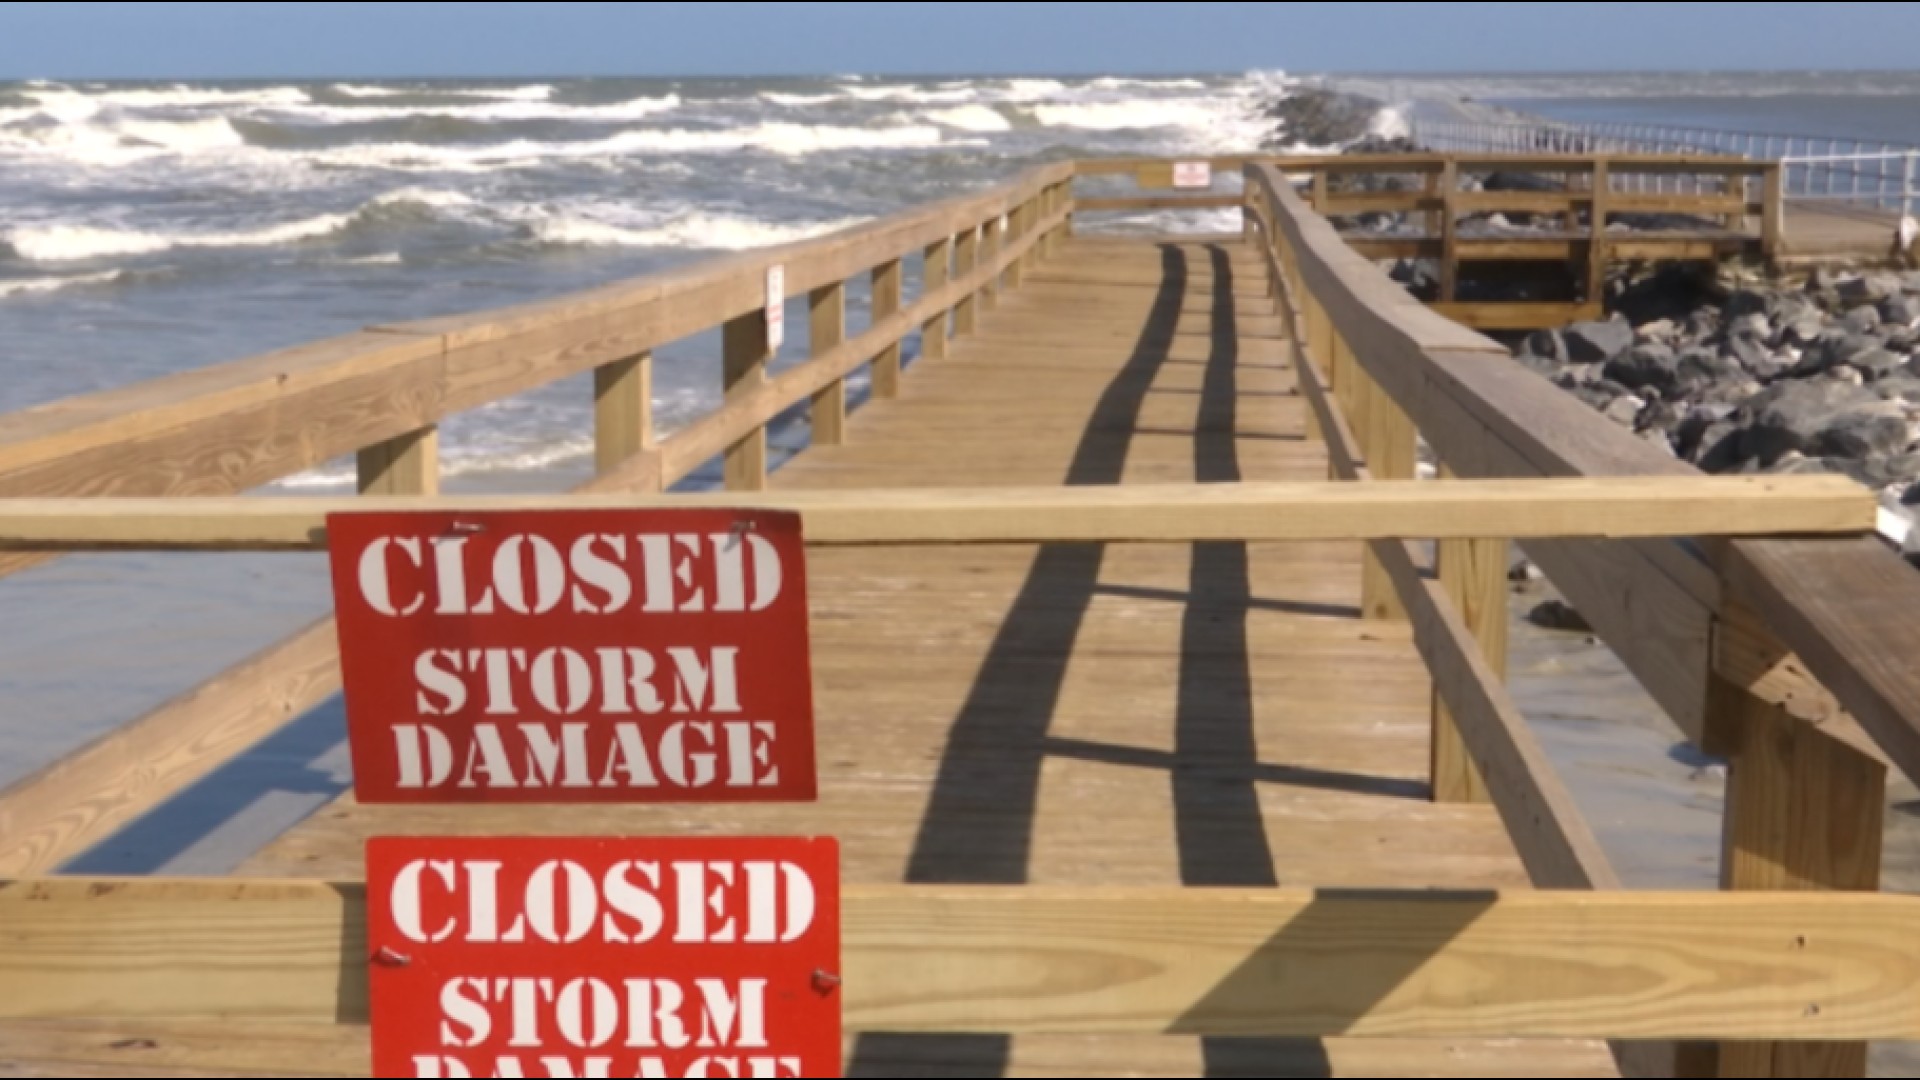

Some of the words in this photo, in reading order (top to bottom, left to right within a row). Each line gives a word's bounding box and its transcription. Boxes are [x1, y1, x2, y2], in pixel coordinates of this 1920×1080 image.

[359, 533, 781, 615] CLOSED
[415, 647, 741, 714] STORM
[391, 722, 778, 788] DAMAGE
[391, 859, 815, 943] CLOSED
[440, 977, 768, 1048] STORM
